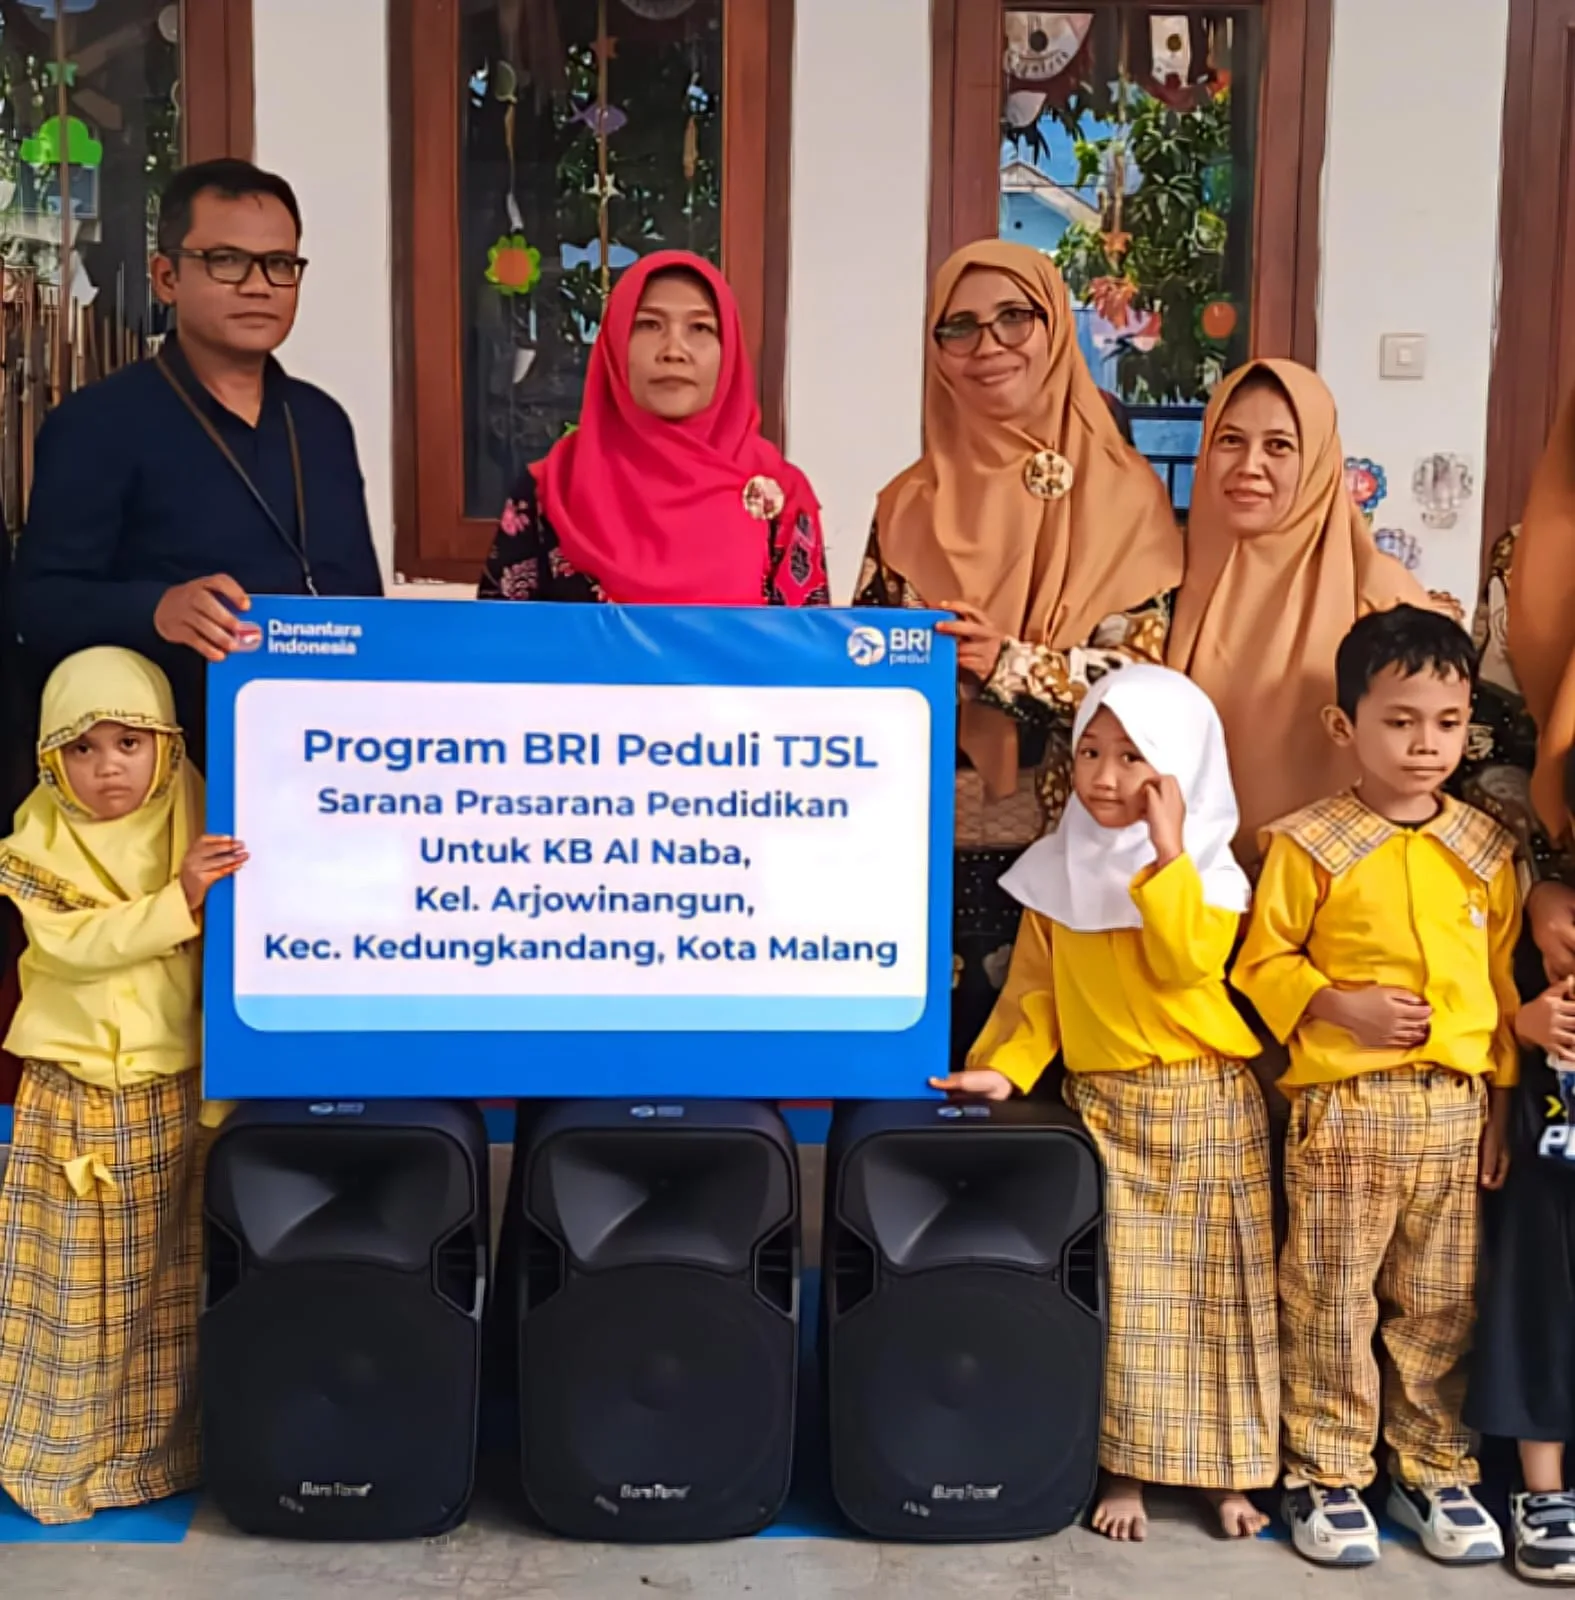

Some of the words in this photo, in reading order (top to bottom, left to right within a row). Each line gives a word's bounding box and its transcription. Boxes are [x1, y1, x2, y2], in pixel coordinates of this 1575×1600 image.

[267, 618, 363, 637] Danantara
[889, 628, 932, 652] BRI
[267, 636, 357, 655] Indonesia
[304, 729, 507, 772] Program
[524, 732, 600, 765] BRI
[617, 732, 760, 767] Peduli
[774, 735, 878, 768] TJSL
[318, 787, 443, 814] Sarana
[456, 789, 635, 816] Prasarana
[647, 790, 848, 817] Pendidikan
[420, 837, 530, 864] Untuk
[543, 838, 593, 864] KB
[603, 838, 639, 864] Al
[651, 838, 751, 869] Naba,
[415, 885, 479, 912] Kel.
[491, 884, 754, 920] Arjowinangun,
[265, 934, 341, 960] Kec.
[353, 933, 665, 967] Kedungkandang,
[677, 935, 757, 961] Kota
[769, 935, 898, 968] Malang
